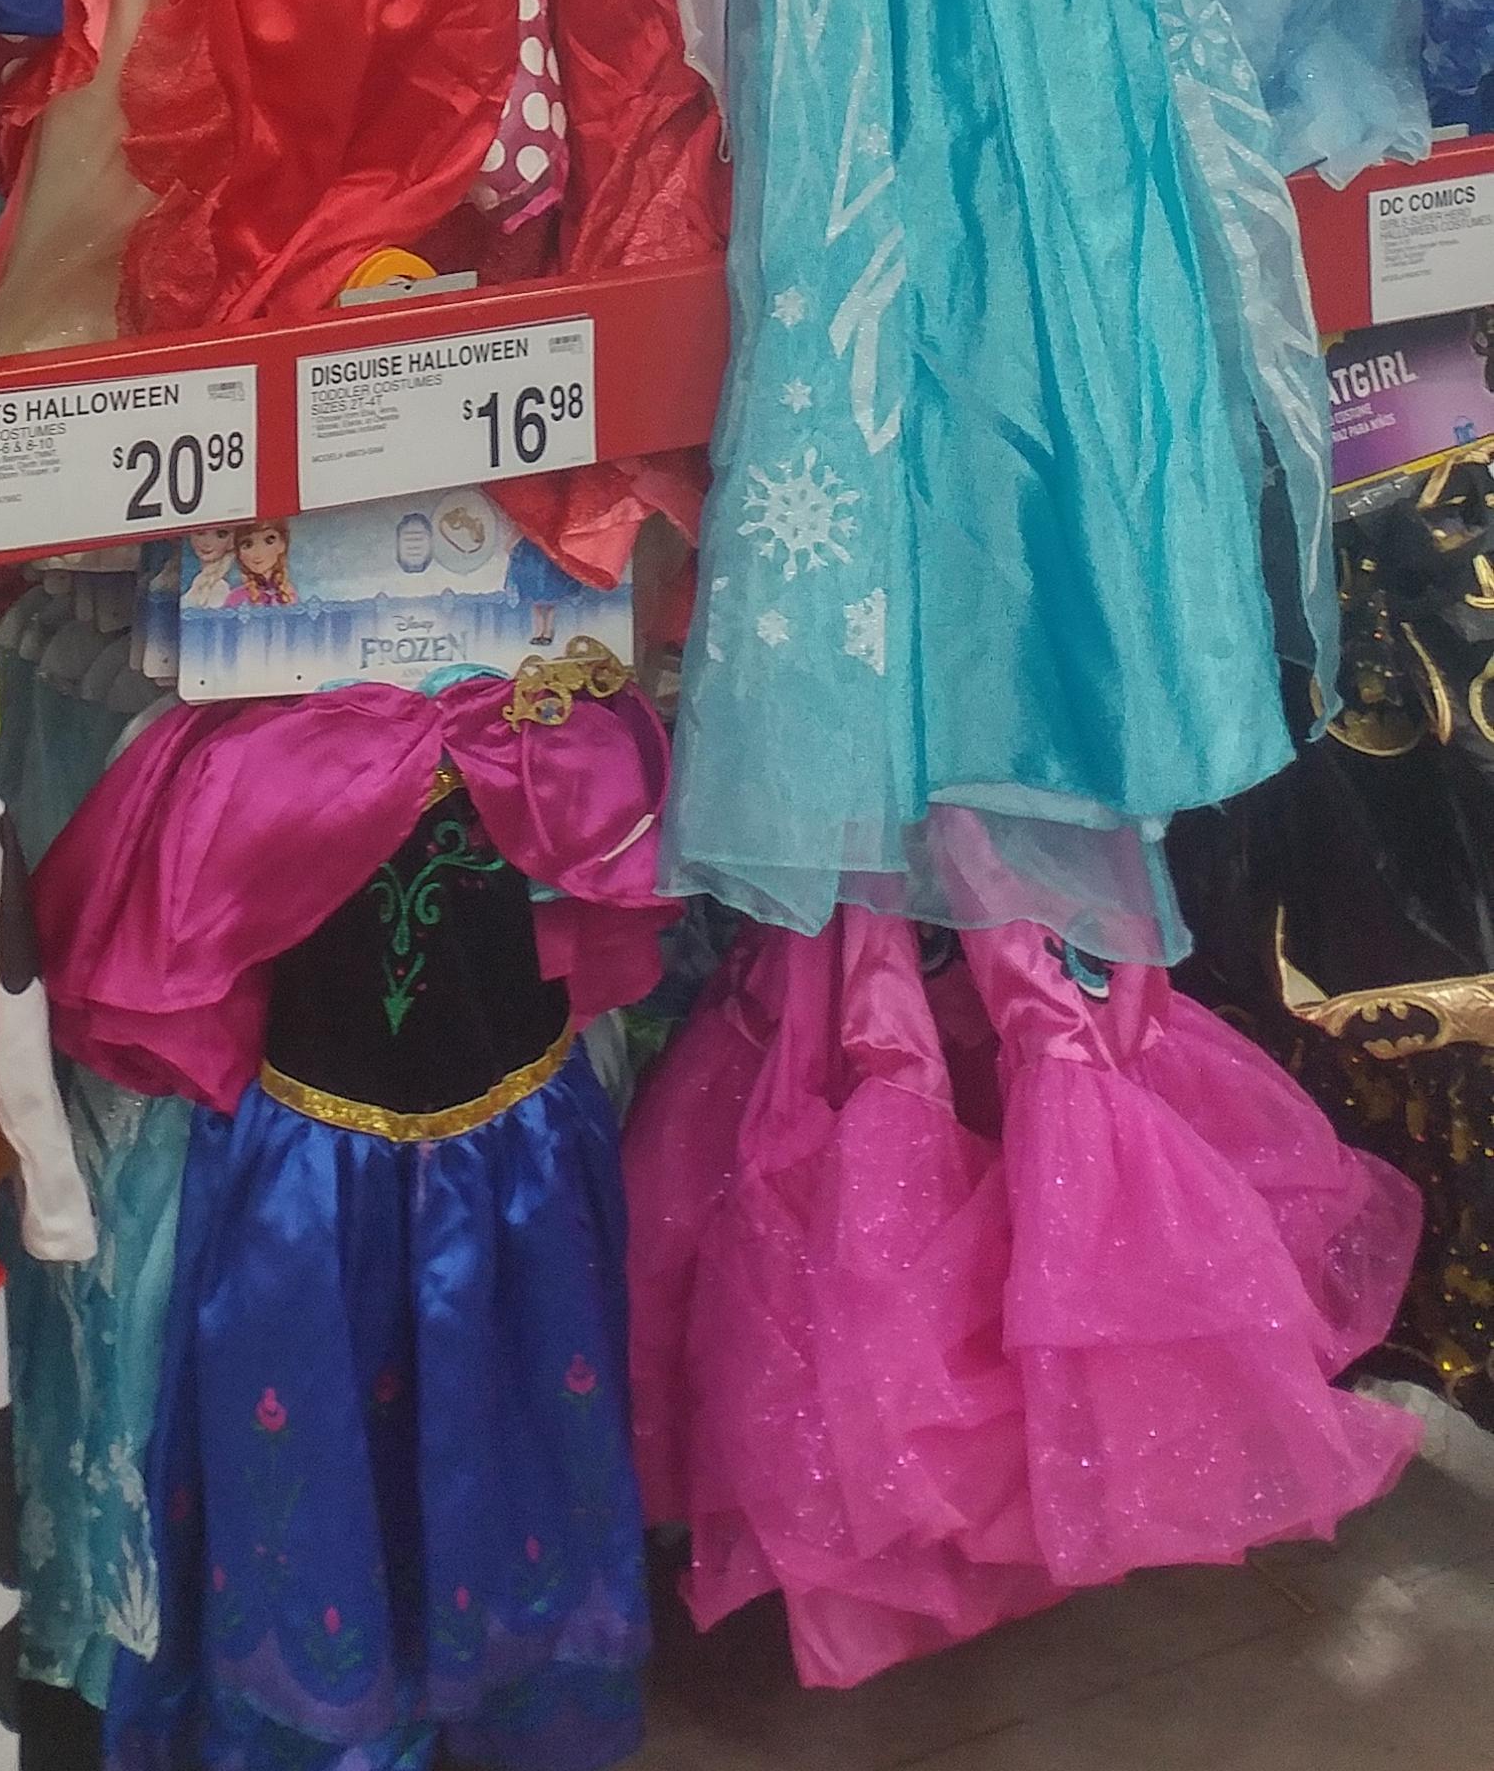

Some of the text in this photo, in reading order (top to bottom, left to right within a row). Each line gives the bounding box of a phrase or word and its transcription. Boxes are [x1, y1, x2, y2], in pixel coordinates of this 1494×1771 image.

[1380, 186, 1476, 216] DC COMICS
[311, 338, 528, 387] DISGUISE HALLOWEEN
[1328, 351, 1419, 405] ATGIRL
[26, 384, 180, 422] HALLOWEEN
[373, 374, 442, 394] COSTUMES
[360, 630, 469, 670] FROZEN
